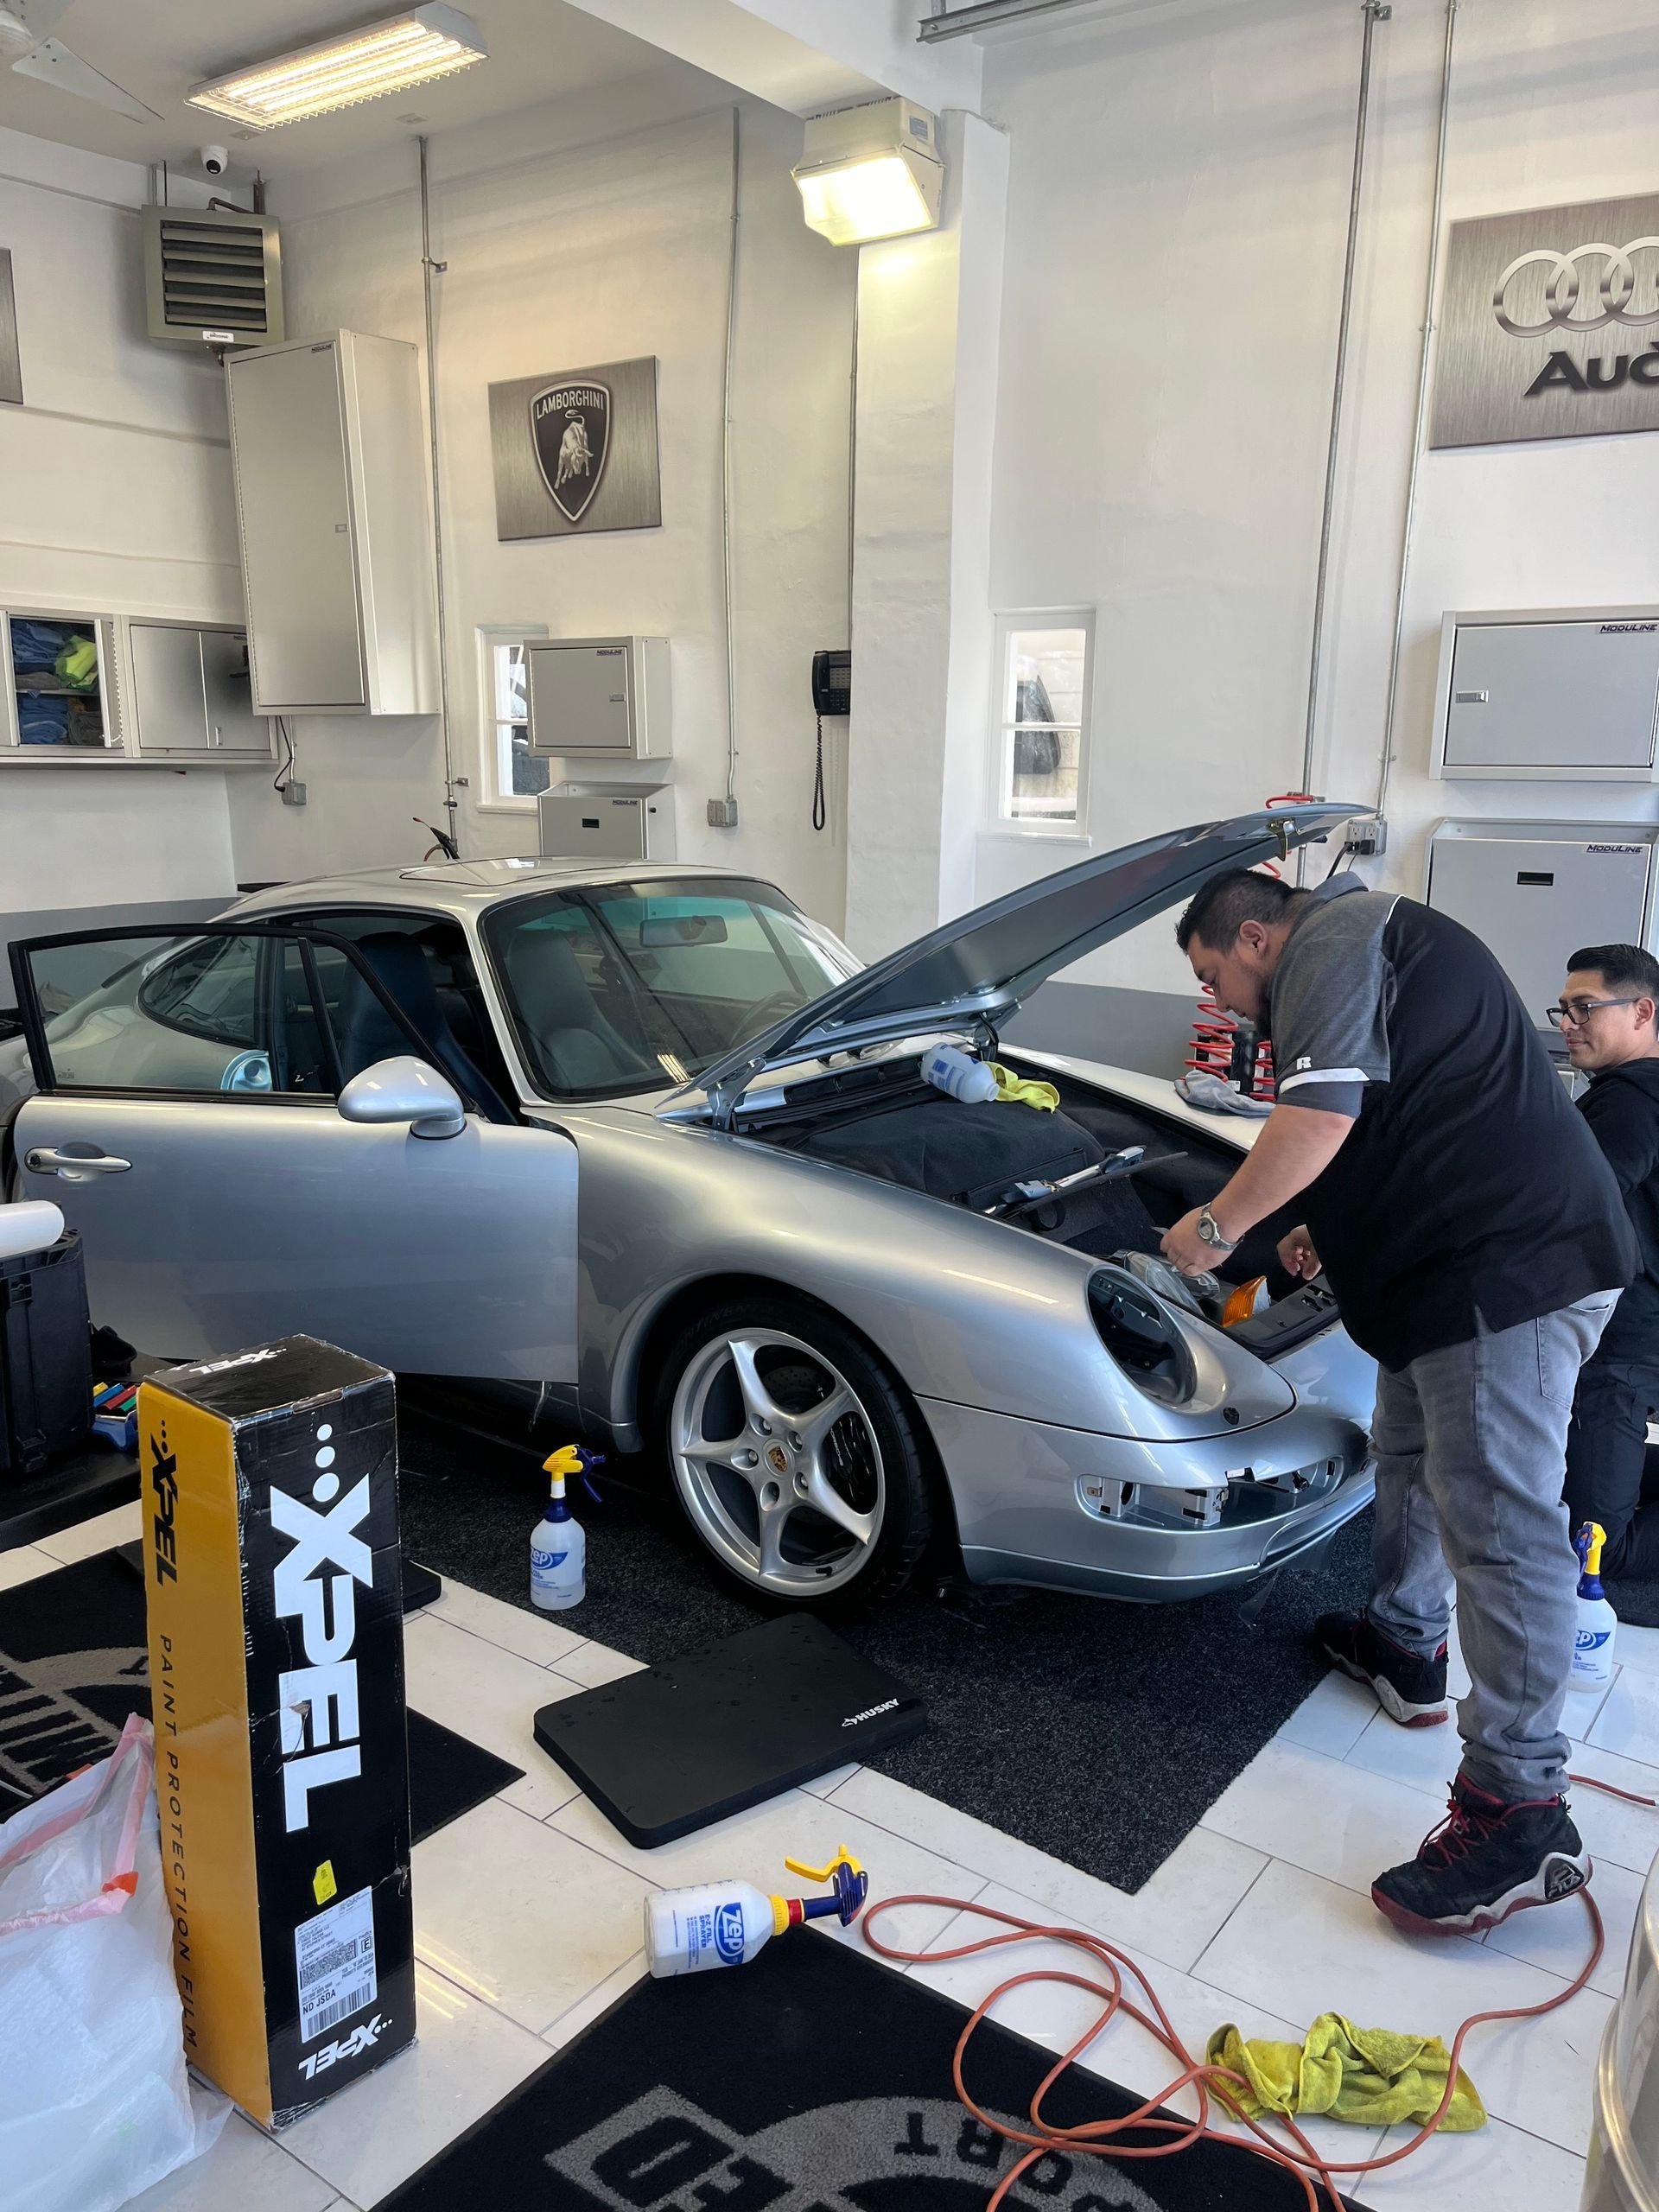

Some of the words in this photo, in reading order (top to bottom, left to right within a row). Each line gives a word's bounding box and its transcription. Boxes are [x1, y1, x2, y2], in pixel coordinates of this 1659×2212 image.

[537, 390, 604, 420] LAMBORGHINI
[1599, 624, 1658, 633] MODULINE
[1586, 844, 1643, 854] MODULINE
[188, 1349, 278, 1374] XPEL
[150, 1433, 179, 1587] XPEL
[270, 1473, 373, 1833] XPEL
[160, 1634, 177, 1737] PAINT
[855, 1698, 899, 1721] HUSKY
[167, 1751, 191, 1961] PROTECTION
[181, 1974, 198, 2048] FILM
[302, 2002, 314, 2015] ND
[316, 1989, 336, 2007] JSDA
[298, 2013, 382, 2080] XPEL
